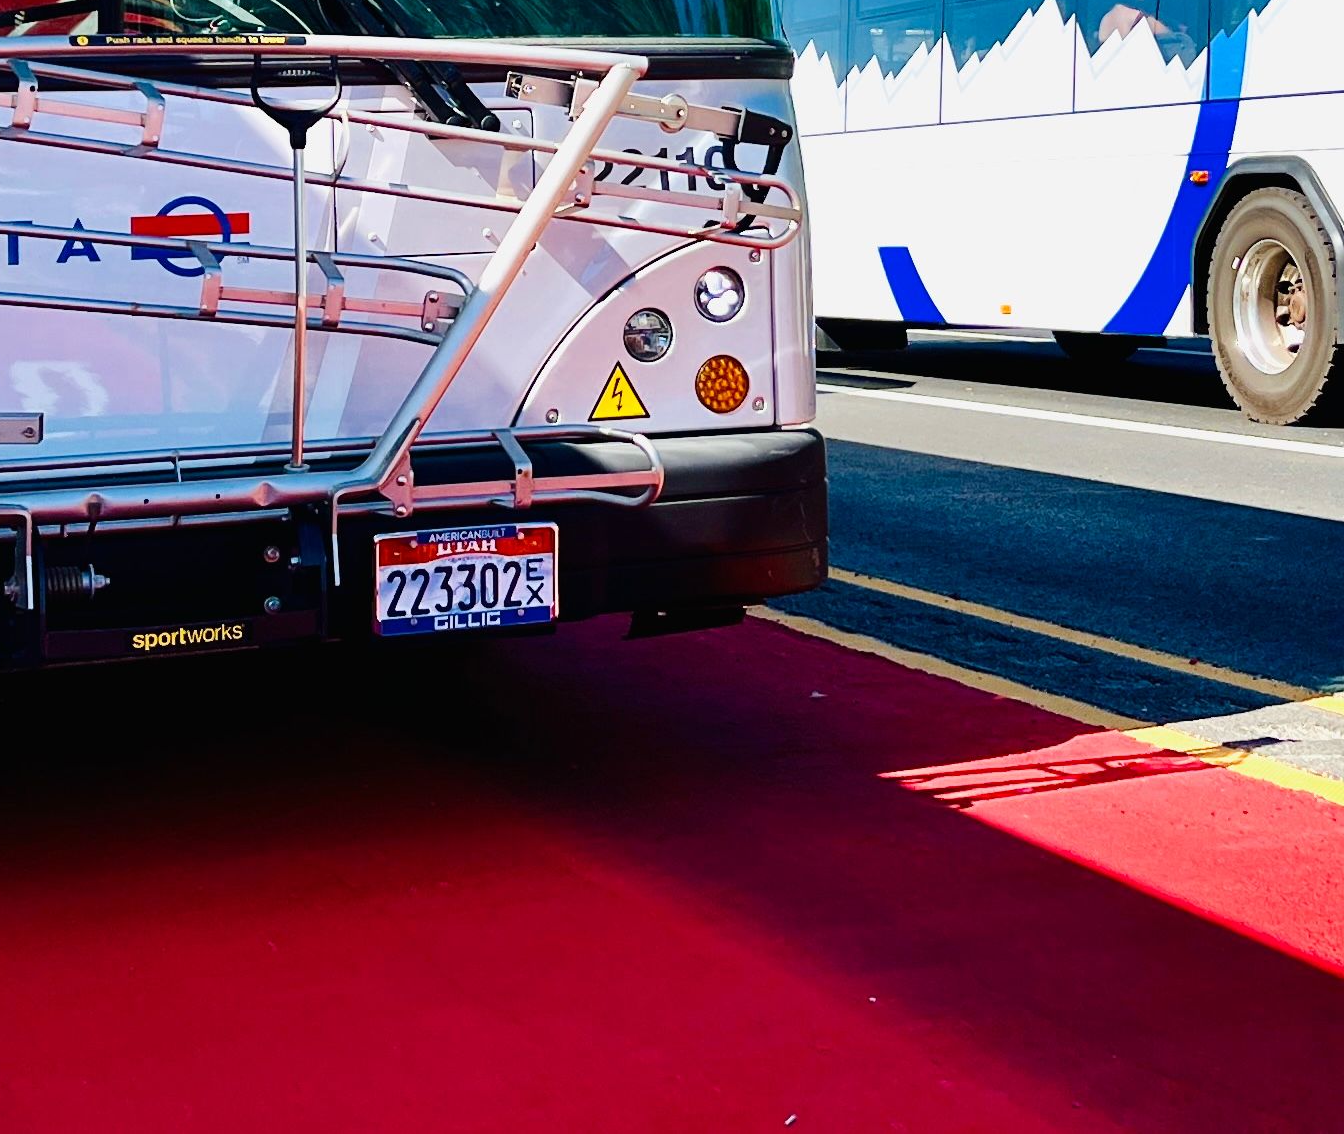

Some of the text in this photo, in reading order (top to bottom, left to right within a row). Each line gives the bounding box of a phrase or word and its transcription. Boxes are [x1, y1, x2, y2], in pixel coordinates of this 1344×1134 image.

[436, 539, 498, 556] UTAH
[386, 560, 522, 617] 223302
[434, 611, 501, 631] GILLIG
[132, 624, 244, 651] sportworks
